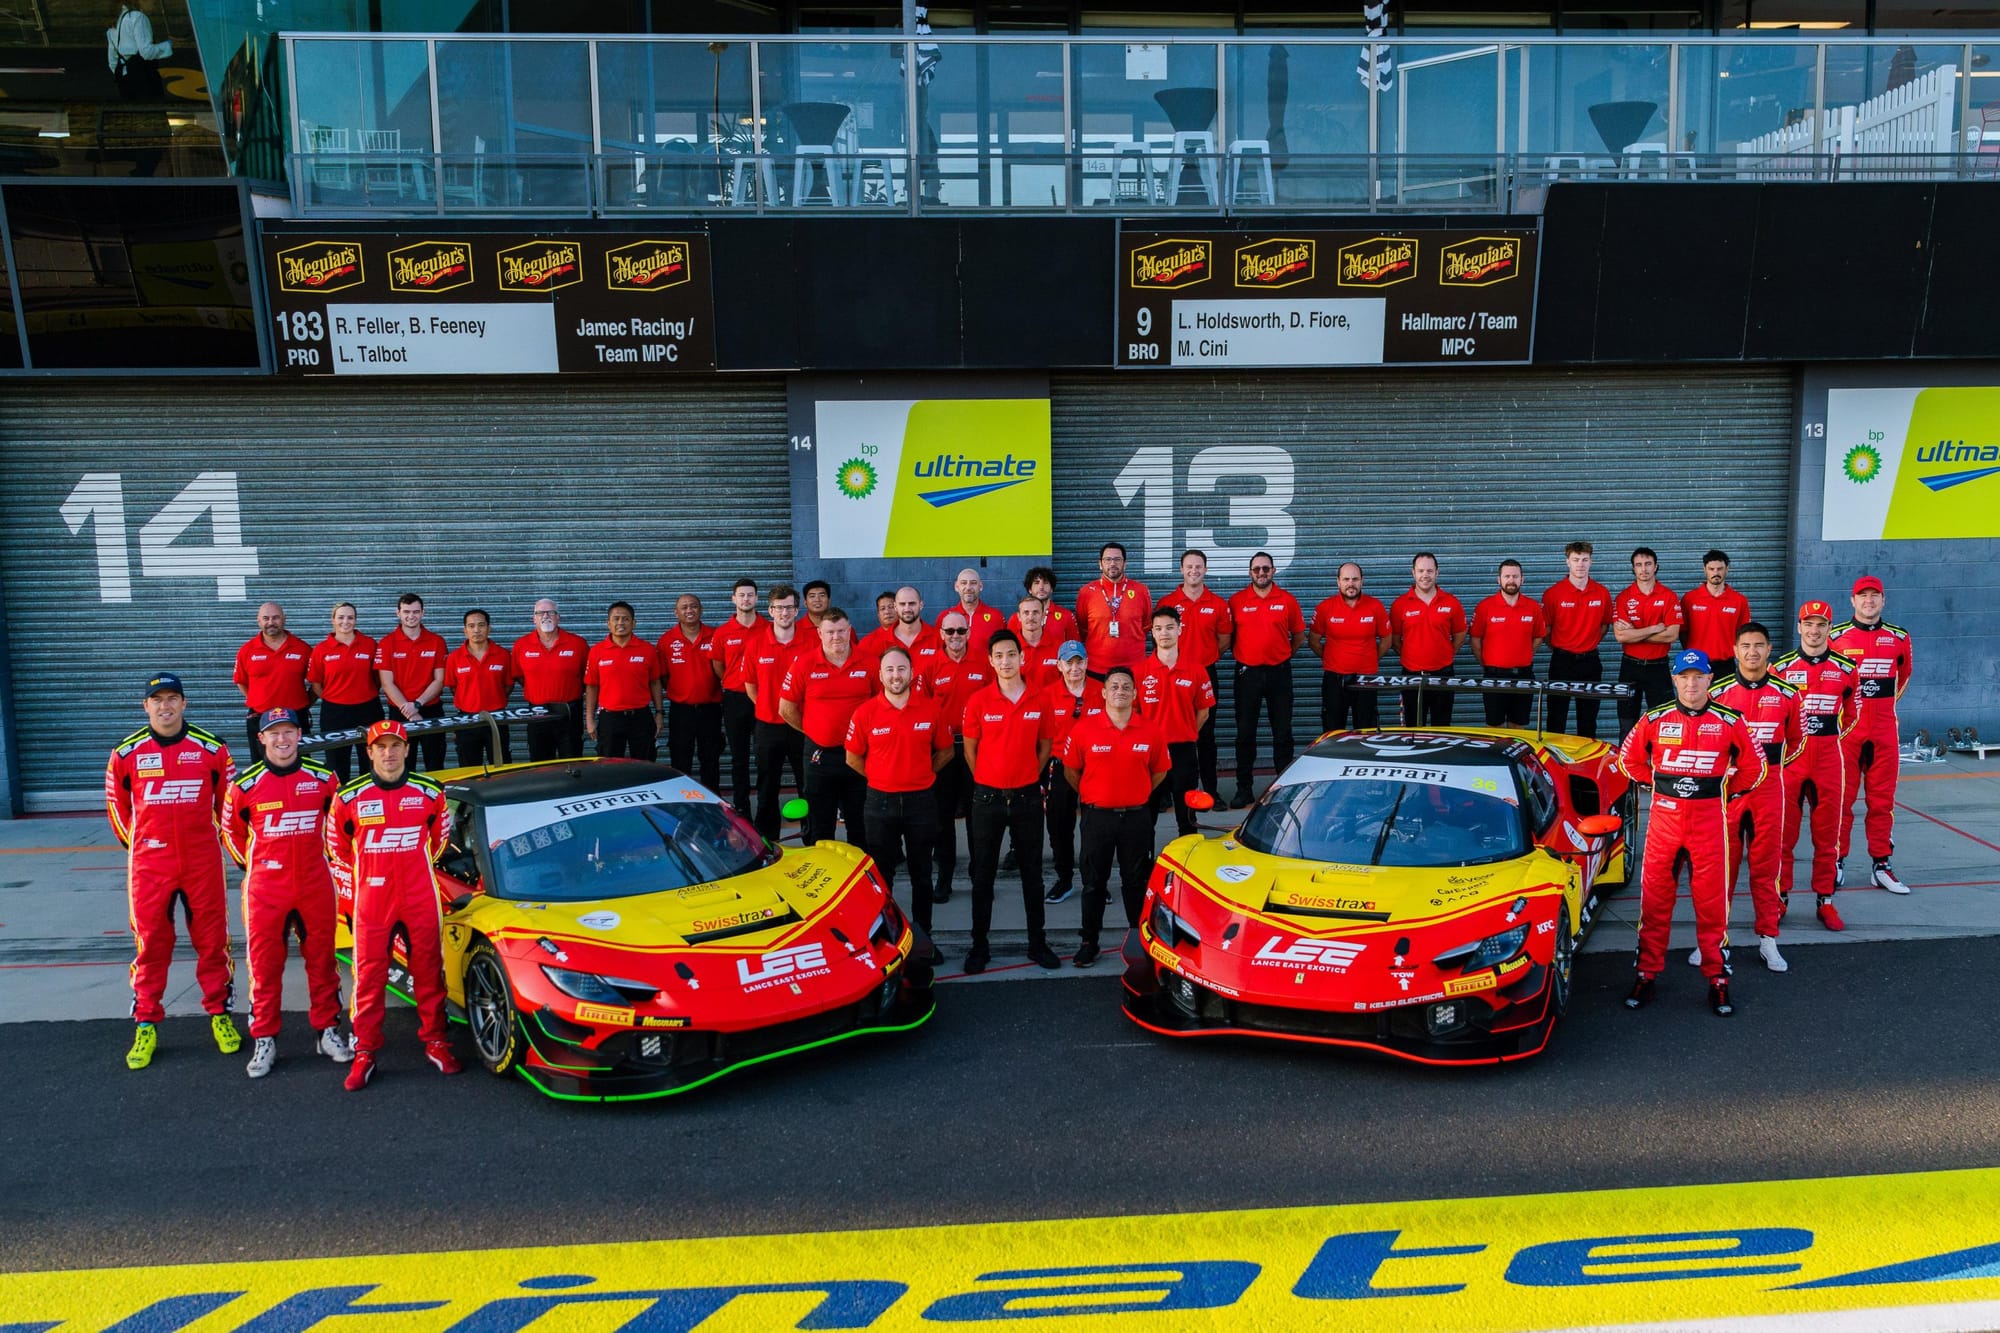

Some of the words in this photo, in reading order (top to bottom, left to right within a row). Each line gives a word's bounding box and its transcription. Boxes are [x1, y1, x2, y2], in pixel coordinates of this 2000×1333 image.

[1085, 160, 1106, 172] 14a
[284, 247, 357, 284] Meguiar's
[394, 246, 466, 285] Meguiar's
[504, 246, 575, 285] Meguiar's
[613, 246, 683, 284] Meguiar's
[1137, 244, 1206, 281] Meguiar's
[1241, 244, 1309, 281] Meguiar's
[1344, 243, 1412, 280] Meguiar's
[1446, 242, 1514, 280] Meguiar's
[276, 311, 324, 342] 183
[336, 318, 353, 335] R.
[356, 317, 406, 339] Feller,
[410, 317, 425, 335] B.
[429, 317, 486, 339] Feeney
[576, 318, 627, 338] Jamec
[631, 318, 684, 342] Racing
[687, 317, 695, 337] /
[1137, 307, 1152, 336] 9
[1179, 313, 1193, 329] L.
[1197, 311, 1285, 331] Holdsworth,
[1290, 312, 1306, 329] D.
[1310, 311, 1351, 331] Fiore,
[1401, 312, 1467, 331] Hallmarc
[1468, 312, 1477, 331] /
[1479, 312, 1518, 330] Team
[339, 346, 354, 363] L.
[357, 345, 408, 363] Talbot
[595, 344, 638, 362] Team
[642, 344, 679, 362] MPC
[1128, 343, 1160, 360] BRO
[1179, 340, 1195, 357] M.
[1199, 340, 1229, 357] Cini
[1441, 338, 1476, 356] MPC
[287, 349, 320, 367] PRO
[1805, 423, 1824, 438] 13
[1868, 429, 1885, 443] bp
[790, 436, 812, 451] 14
[861, 442, 879, 457] bp
[913, 453, 1037, 477] ultimate
[1113, 445, 1297, 576] 13
[59, 472, 260, 602] 14
[1859, 658, 1894, 673] EE
[1357, 675, 1441, 686] LANCE
[1446, 678, 1511, 688] EAST
[1516, 680, 1629, 692] EXOTICS
[1804, 693, 1839, 710] EE
[1338, 734, 1496, 748] FUCHS
[1661, 748, 1720, 769] LEE
[1339, 766, 1449, 782] Ferrari
[143, 779, 203, 801] LEE
[1471, 777, 1497, 791] 36
[1673, 782, 1700, 792] FUCHS
[554, 790, 663, 817] Ferrari
[263, 810, 320, 832] LEE
[364, 825, 422, 849] LEE
[1287, 893, 1368, 909] Swisstrax
[693, 908, 767, 932] Swisstrax
[1536, 920, 1555, 935] KFC
[1254, 935, 1367, 967] LEE
[736, 942, 827, 985] LEE
[1251, 959, 1281, 968] LANCE
[1283, 961, 1306, 970] EAST
[1307, 963, 1347, 974] EXOTICS
[743, 981, 774, 994] LANCE
[773, 975, 795, 988] EAST
[796, 967, 832, 982] EXOTICS
[1450, 975, 1493, 993] PIRELLI
[1369, 1000, 1397, 1009] KELSO
[1397, 991, 1445, 1006] ELECTRICAL
[581, 1006, 631, 1024] PIRELLI
